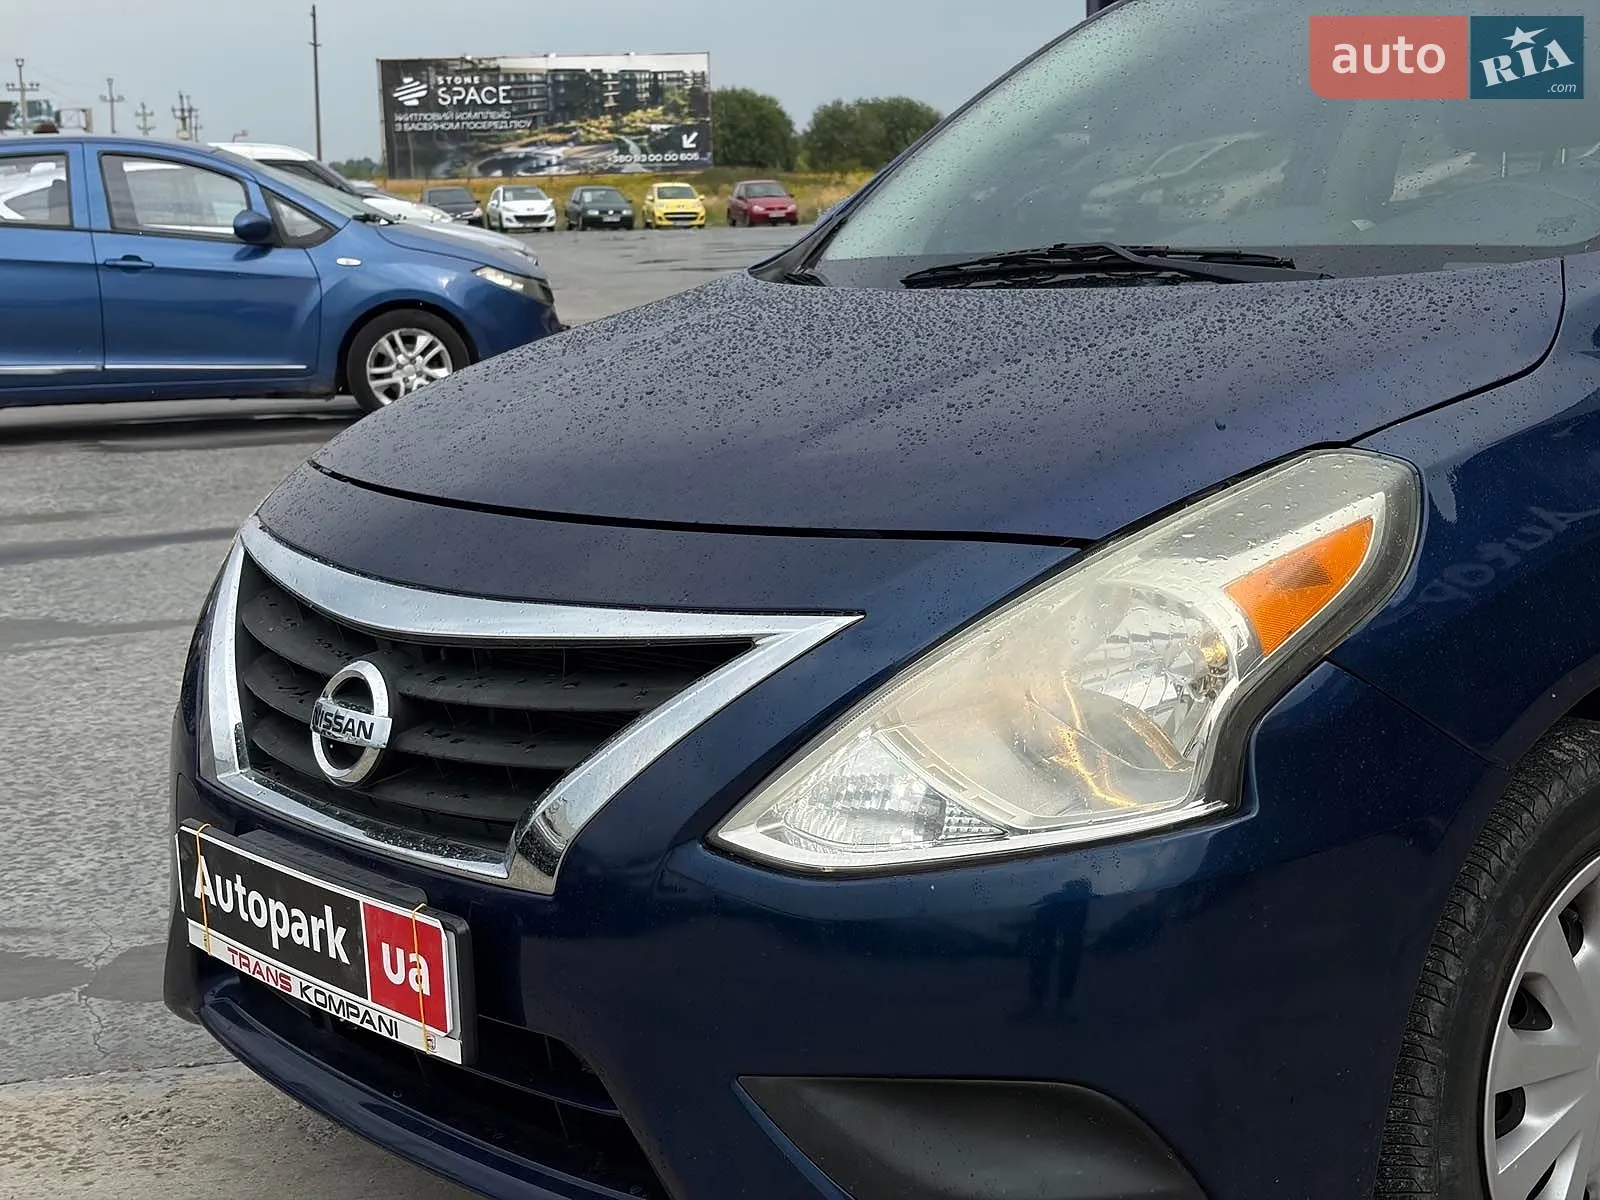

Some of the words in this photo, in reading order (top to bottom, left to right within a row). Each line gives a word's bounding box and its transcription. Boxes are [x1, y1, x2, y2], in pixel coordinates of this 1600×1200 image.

[436, 75, 480, 85] STONE
[437, 85, 513, 106] SPACE
[312, 702, 375, 740] NISSAN
[194, 854, 351, 965] Autopark
[381, 941, 431, 997] ua
[226, 947, 292, 993] TRANS
[299, 981, 400, 1039] KOMPANI
